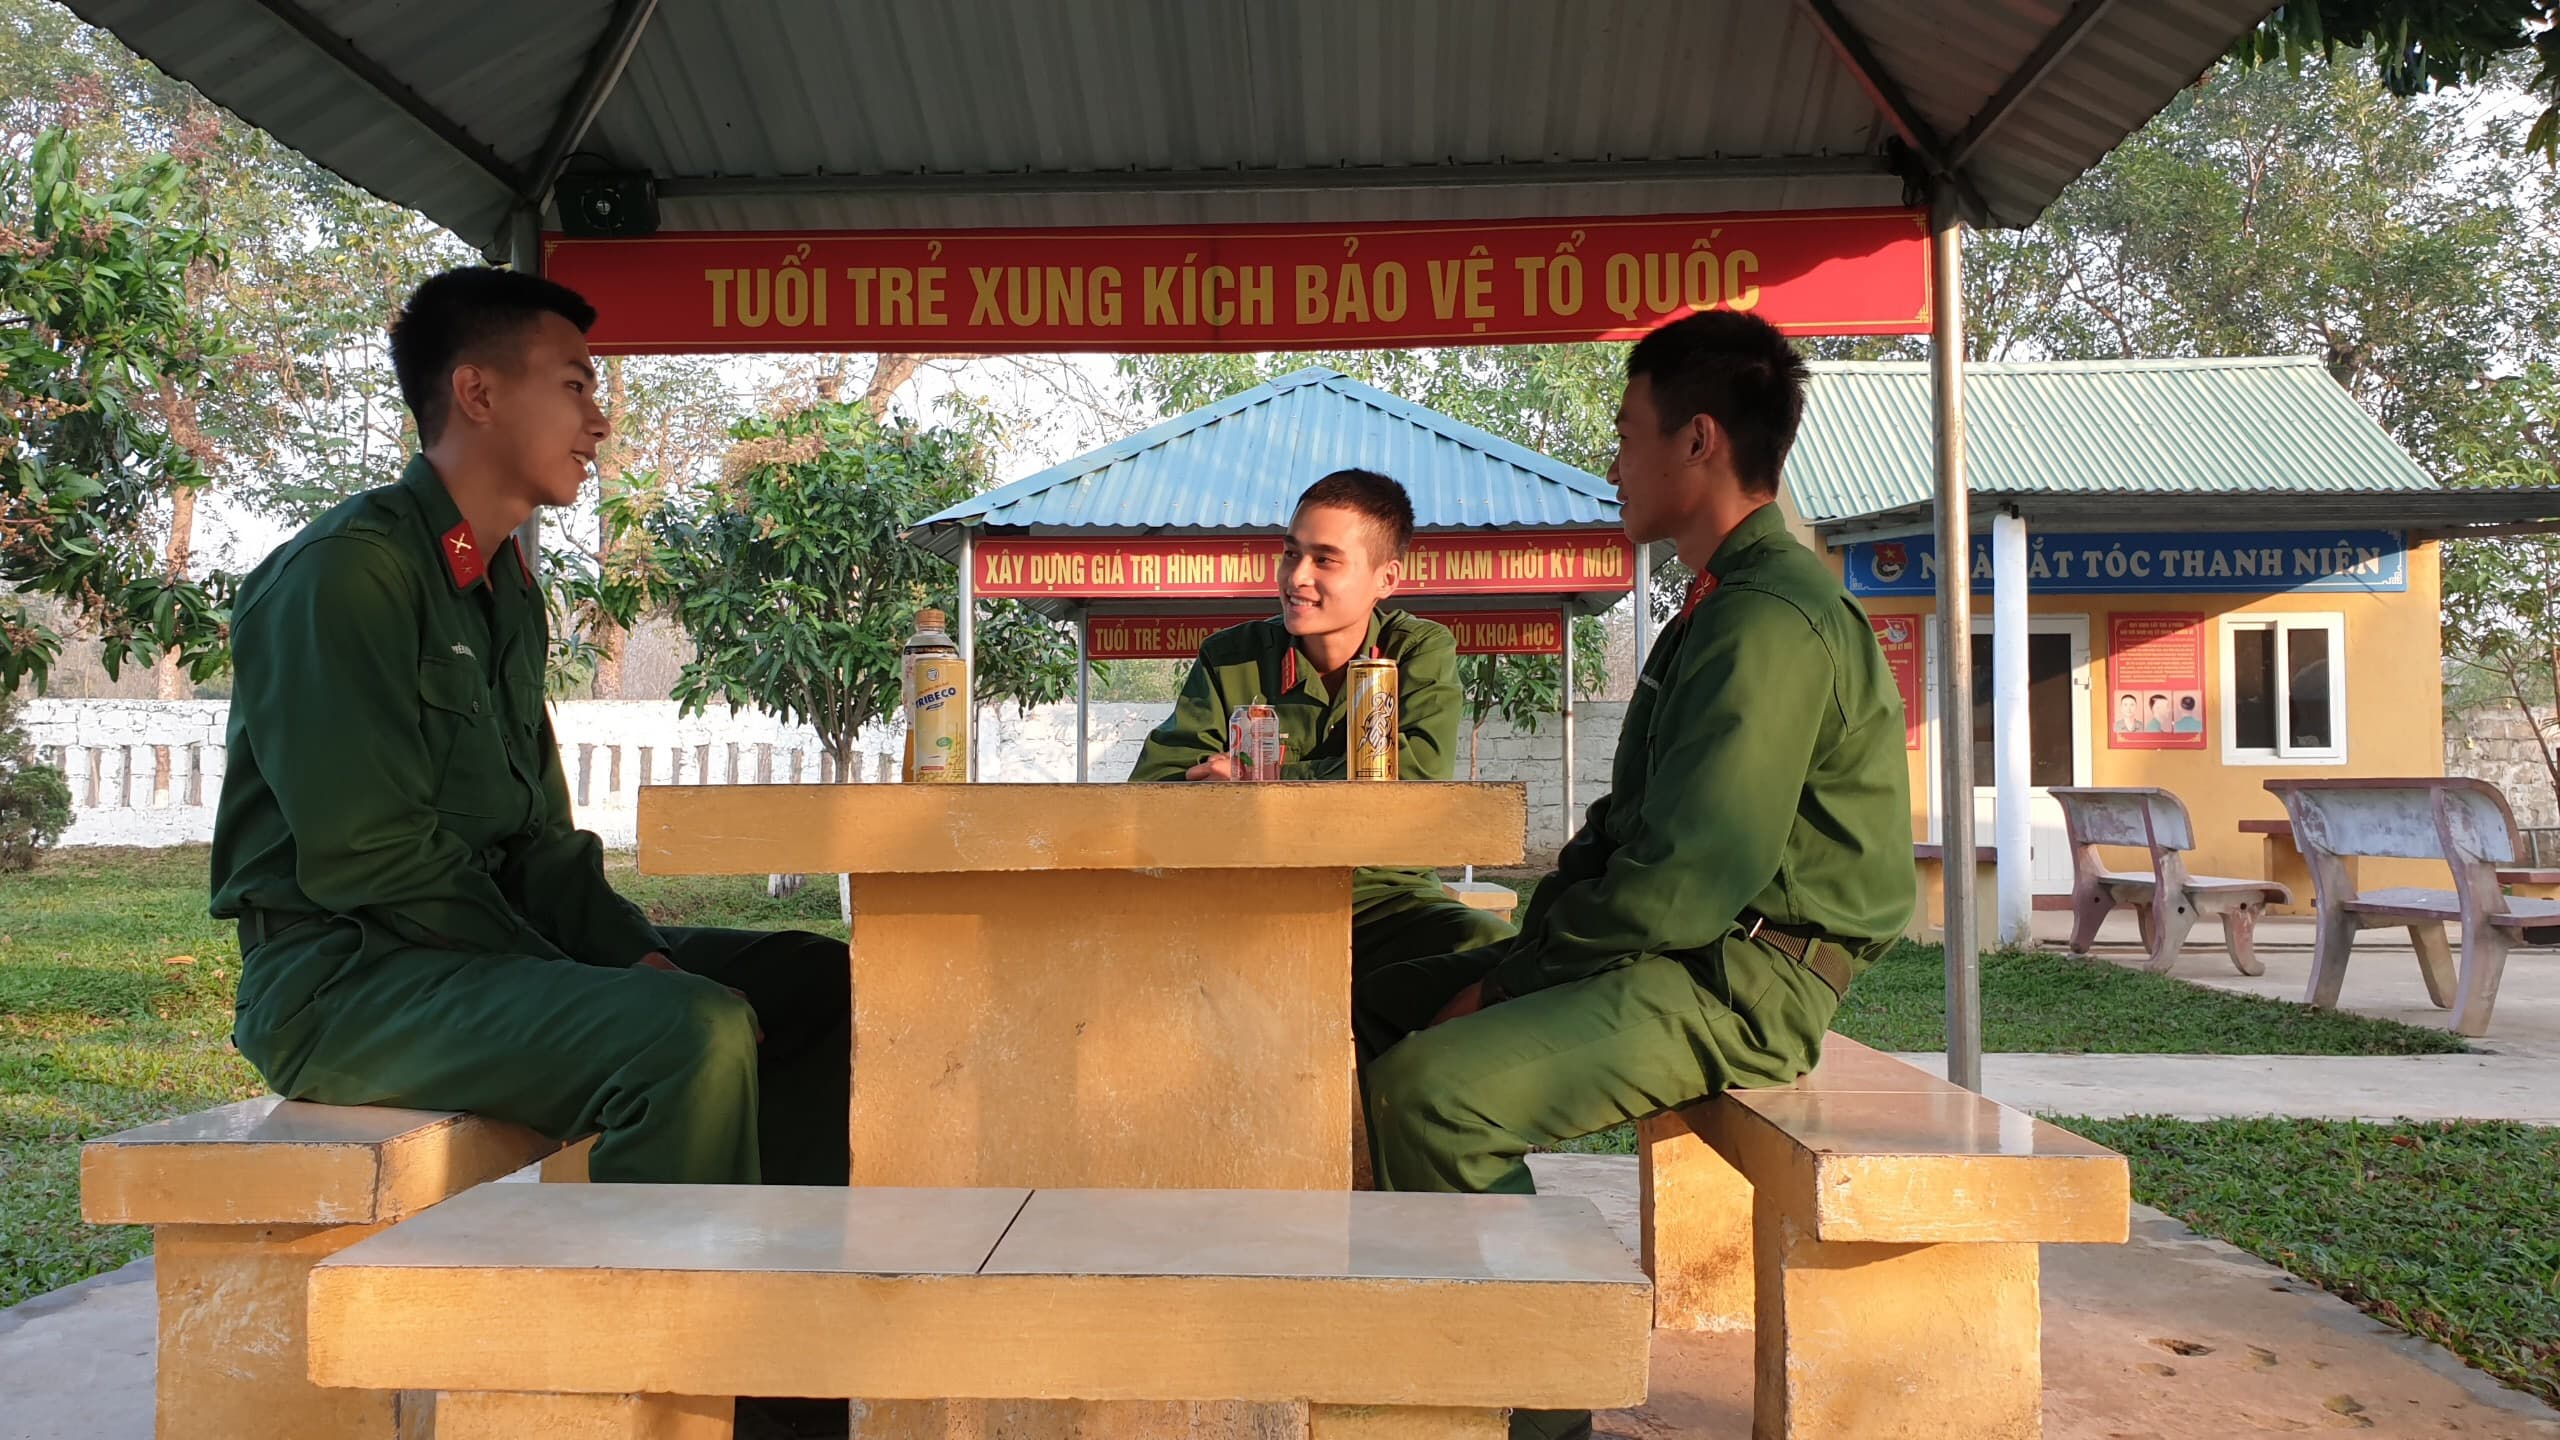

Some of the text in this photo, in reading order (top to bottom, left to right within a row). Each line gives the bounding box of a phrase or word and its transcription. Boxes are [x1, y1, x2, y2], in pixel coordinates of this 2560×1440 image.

[705, 228, 1760, 332] TUỔI TRẺ XUNG KÍCH BẢO VỆ TỔ QUỐC
[985, 549, 1025, 585] XÂY
[1030, 552, 1085, 591] DỰNG
[1091, 548, 1125, 585] GIÁ
[1130, 555, 1161, 591] TRỊ
[1167, 548, 1215, 584] HÌNH
[1221, 542, 1266, 584] MẪU
[1446, 550, 1492, 580] NAM
[1499, 541, 1544, 579] THỜI
[1551, 542, 1577, 578] KỲ
[1583, 538, 1622, 577] MỚI
[1920, 537, 2380, 579] NÀ ẮT TÓC THANH NIÊN
[1095, 618, 1130, 651] TUỔI
[1134, 618, 1161, 650] TRẺ
[1476, 624, 1518, 647] KHOA
[1523, 623, 1554, 650] HỌC
